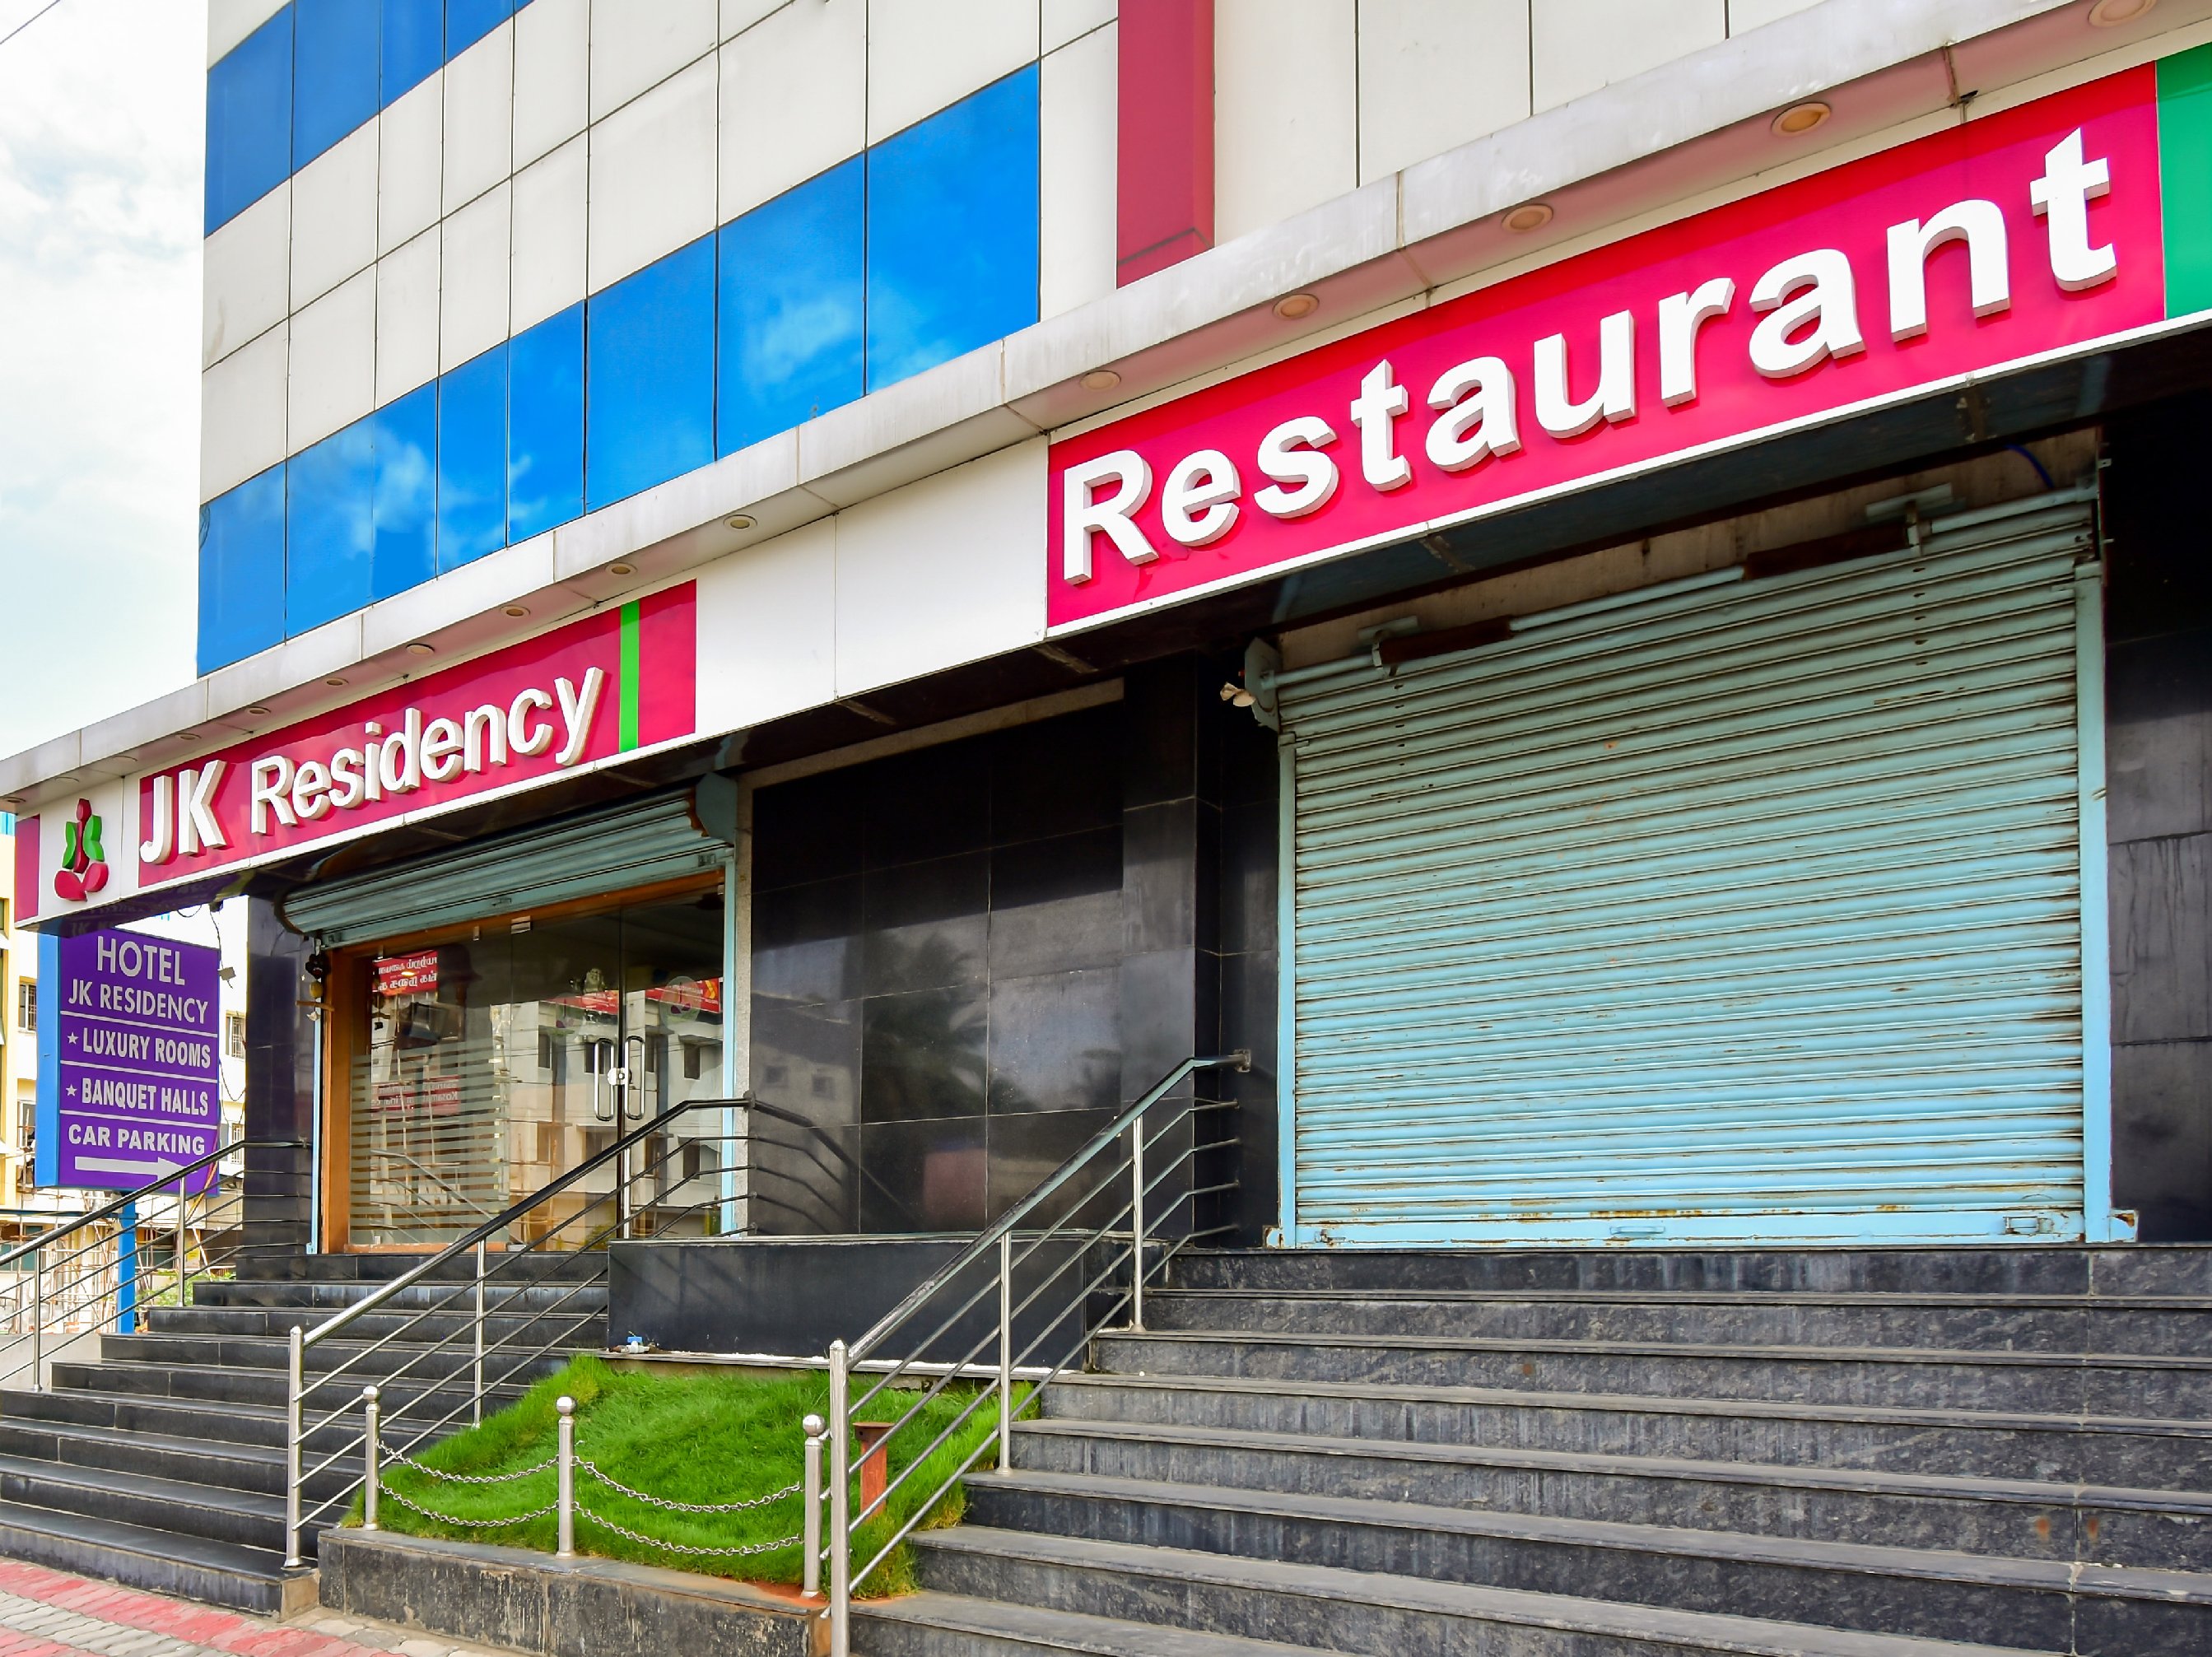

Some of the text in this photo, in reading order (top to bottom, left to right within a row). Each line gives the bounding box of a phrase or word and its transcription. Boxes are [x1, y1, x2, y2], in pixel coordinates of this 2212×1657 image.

[1061, 127, 2118, 585] Restaurant
[140, 666, 603, 864] JK Residency
[97, 936, 185, 986] HOTEL
[68, 979, 207, 1024] JK RESIDENCY
[83, 1027, 211, 1068] LUXURY ROOMS
[82, 1078, 207, 1116] BANQUET HALLS
[68, 1124, 205, 1156] CAR PARKING
